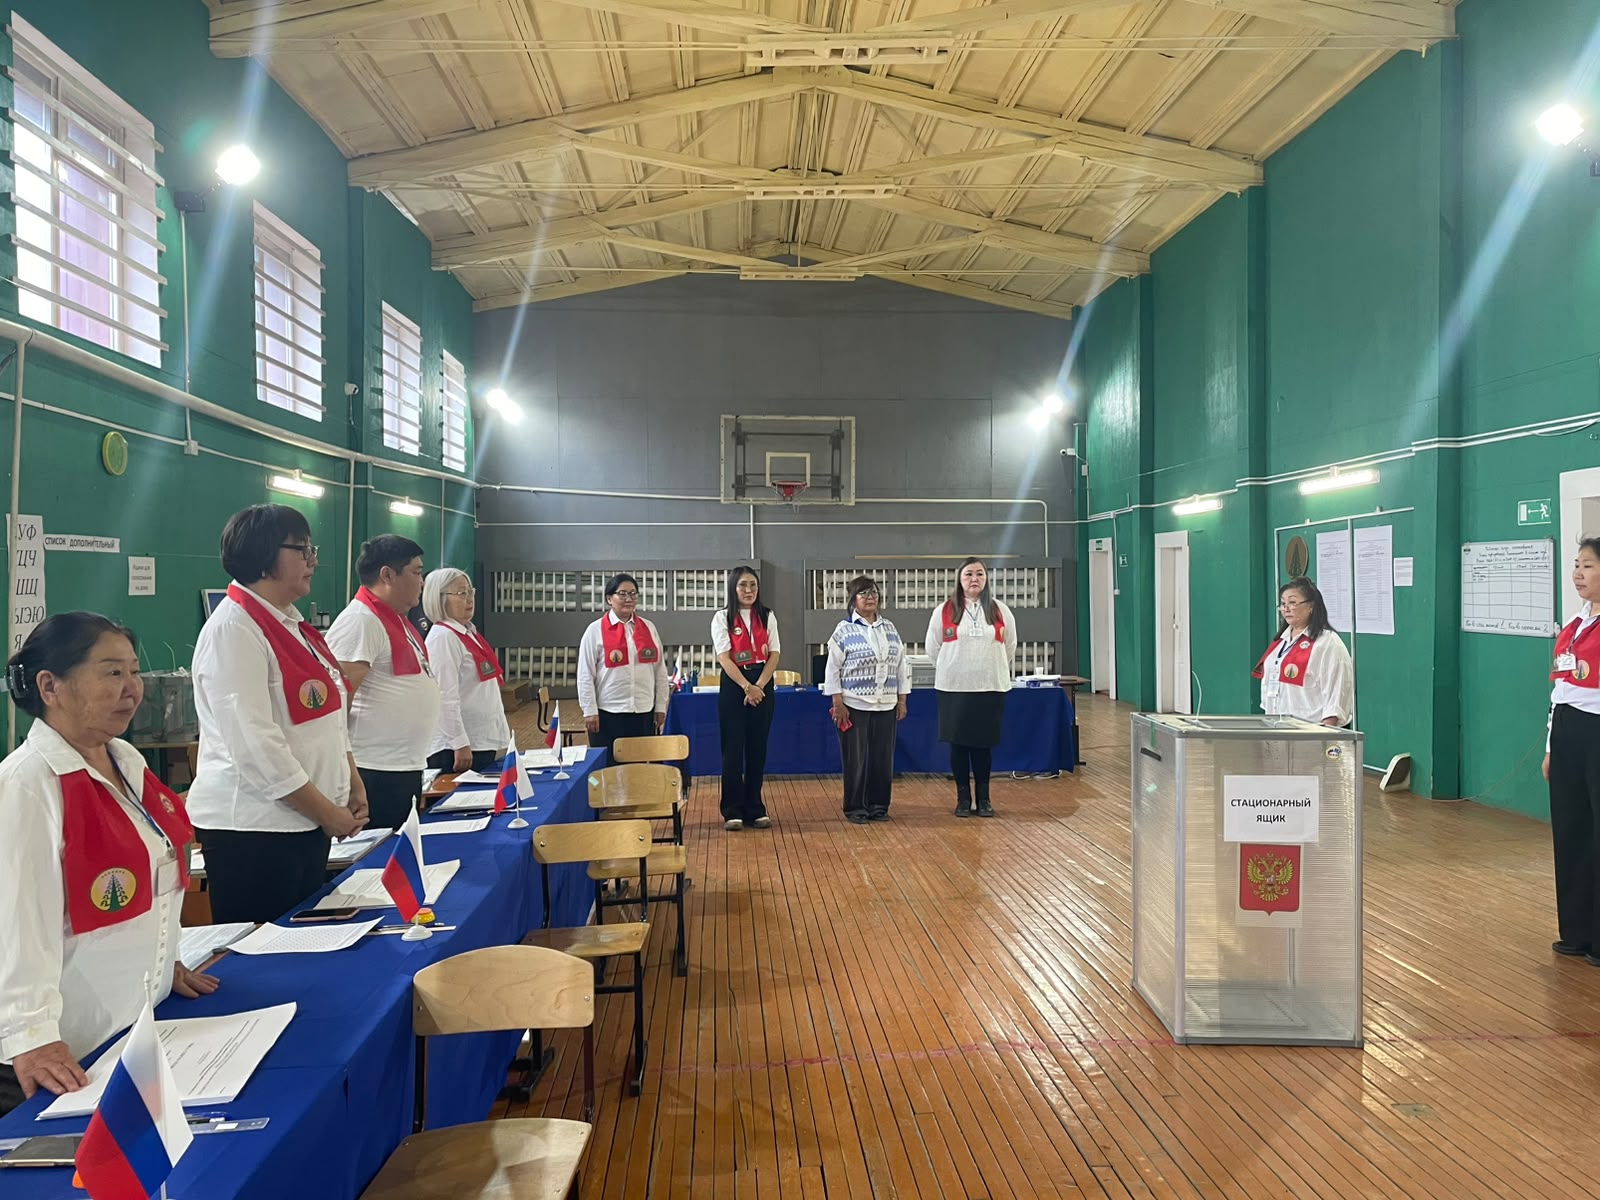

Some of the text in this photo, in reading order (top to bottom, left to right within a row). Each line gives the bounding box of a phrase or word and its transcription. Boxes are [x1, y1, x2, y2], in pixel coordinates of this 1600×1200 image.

[15, 523, 37, 541] УФ
[45, 537, 115, 549] СПИСОК ДОПОЛНИТЕЛЬНЫЙ
[17, 549, 37, 568] ЦЧ
[1230, 798, 1311, 808] СТАЦИОНАРНЫЙ
[1256, 814, 1286, 824] ЯЩИК
